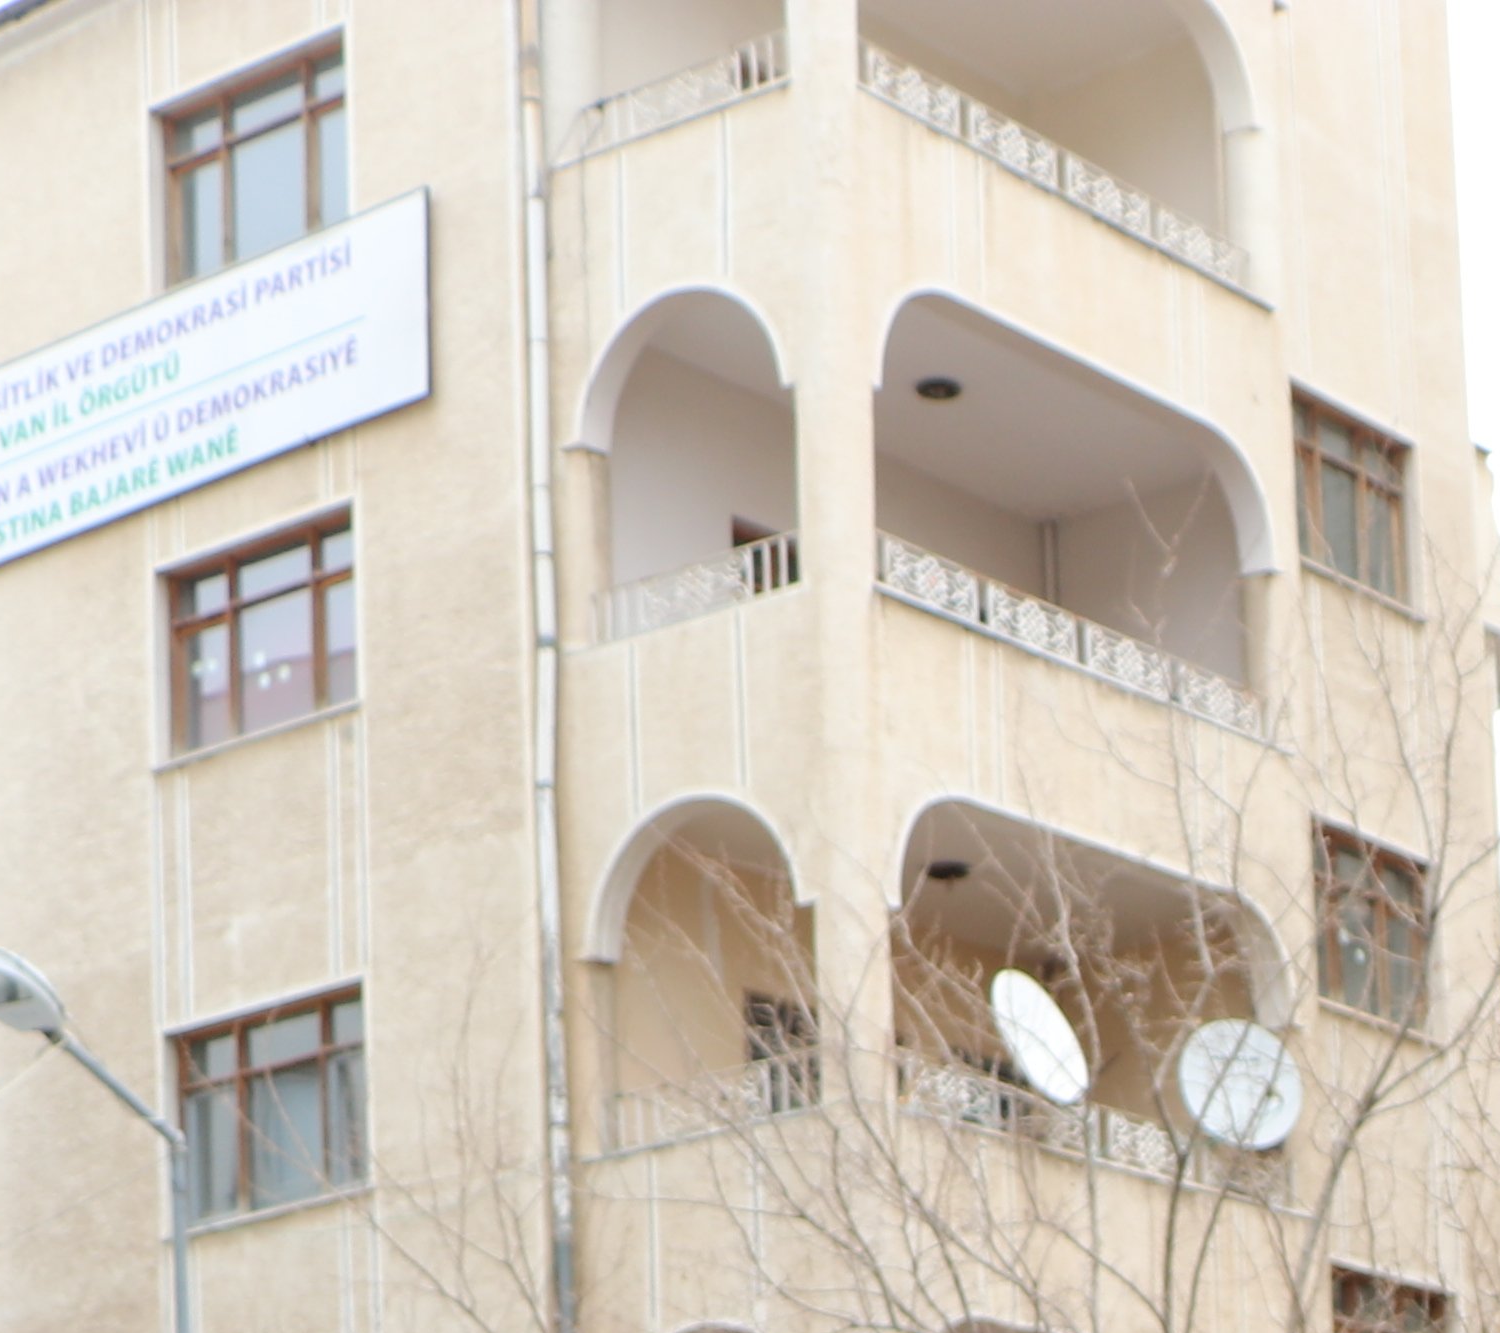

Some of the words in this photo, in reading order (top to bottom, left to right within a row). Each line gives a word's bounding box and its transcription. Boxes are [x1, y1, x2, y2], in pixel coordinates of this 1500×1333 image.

[64, 351, 94, 384] VE
[100, 280, 247, 369] DEMOKRASİ
[254, 236, 352, 304] PARTİSİ
[52, 397, 72, 428] İL
[78, 350, 180, 416] ÖRGÜTÜ
[17, 473, 31, 498] A
